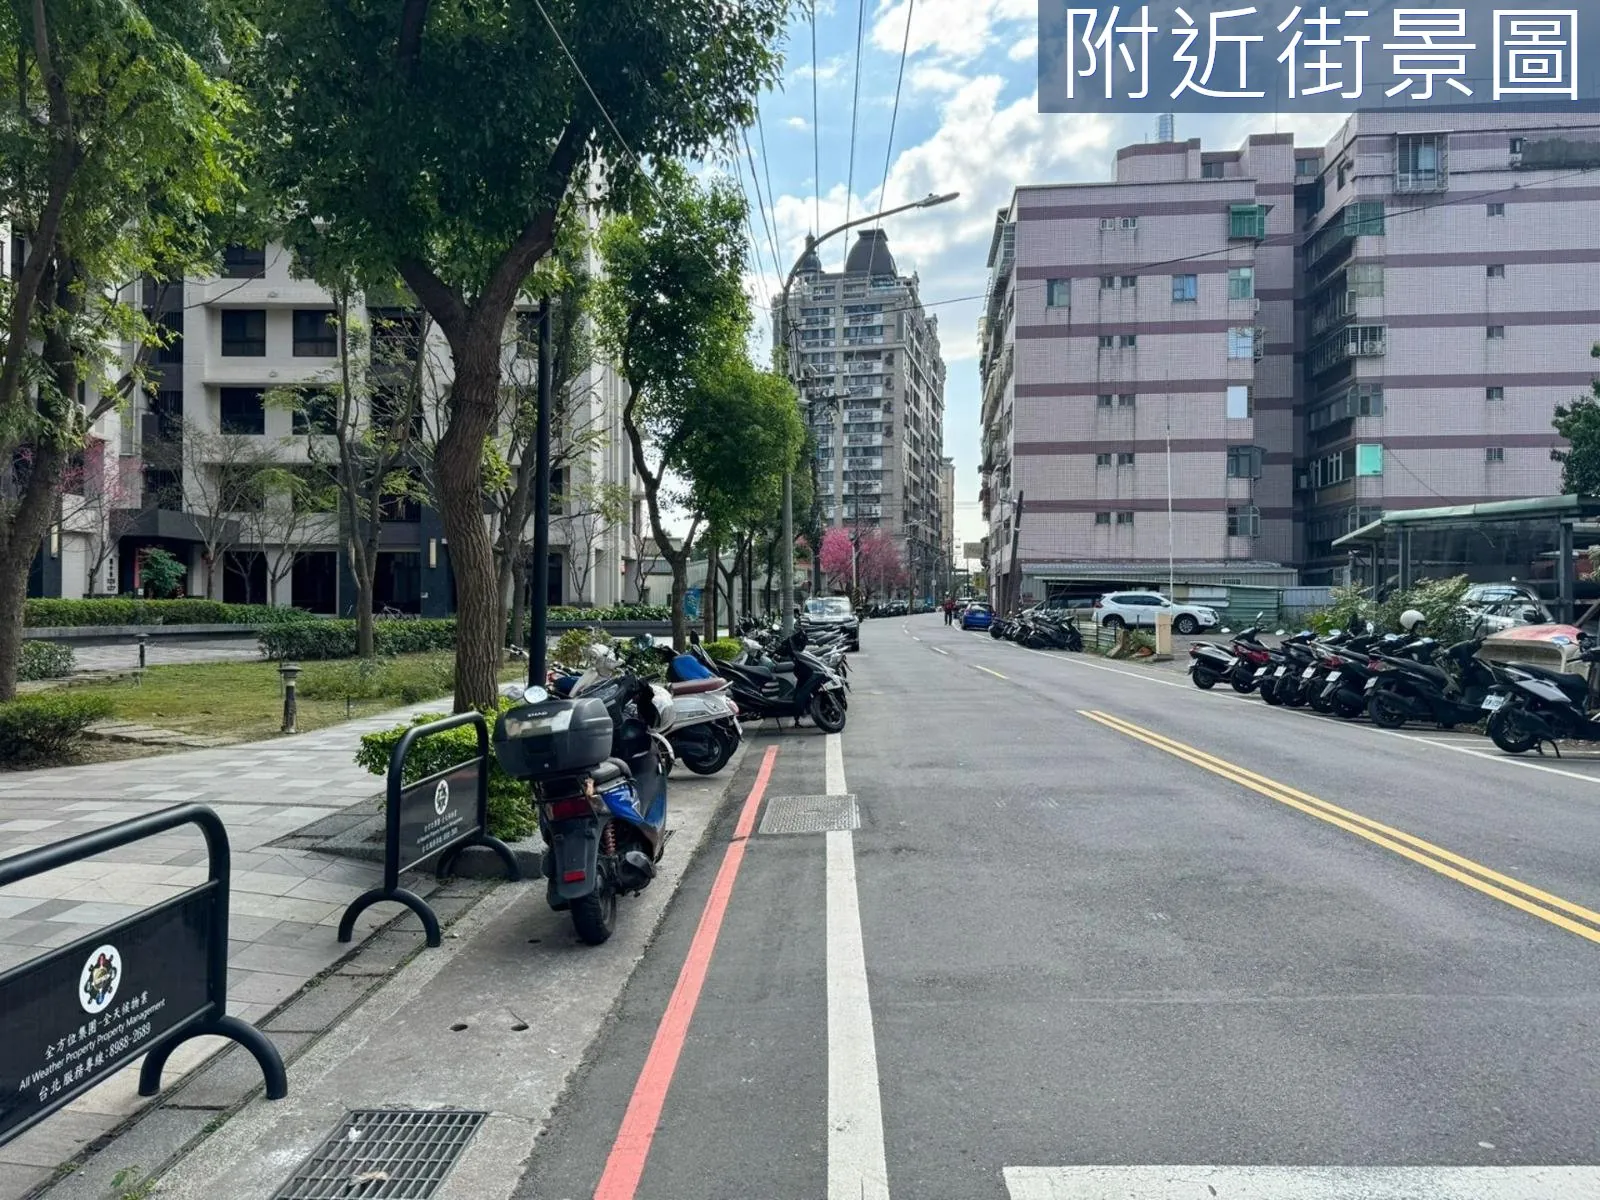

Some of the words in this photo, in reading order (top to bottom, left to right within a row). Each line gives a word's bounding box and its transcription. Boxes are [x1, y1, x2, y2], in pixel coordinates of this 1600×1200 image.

[19, 1076, 31, 1092] All
[31, 1058, 65, 1083] Weather
[66, 1039, 96, 1063] Property
[97, 1023, 126, 1044] Property
[126, 998, 165, 1028] Management
